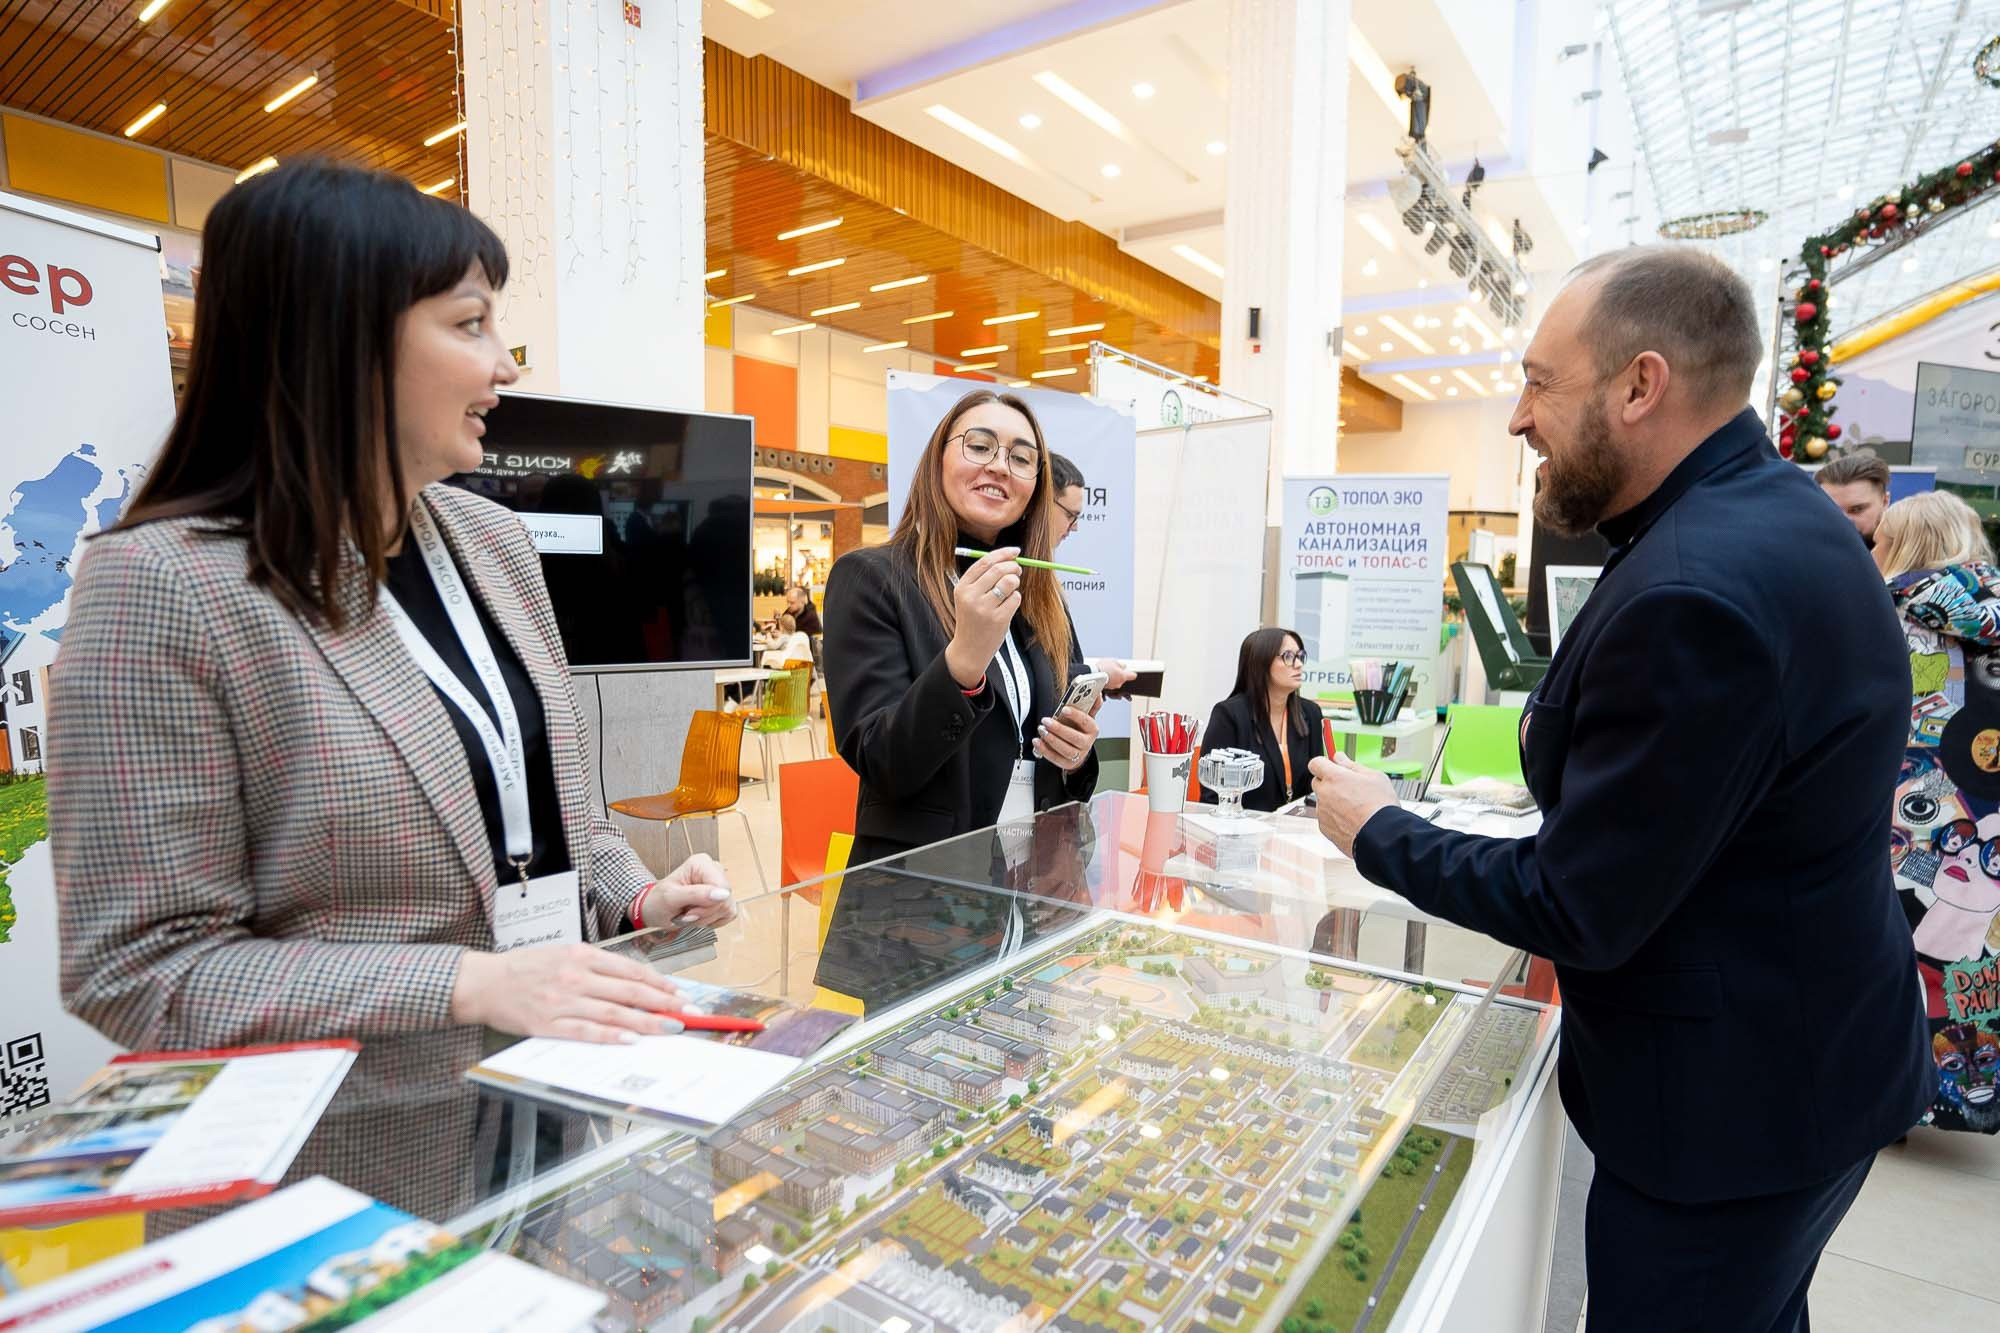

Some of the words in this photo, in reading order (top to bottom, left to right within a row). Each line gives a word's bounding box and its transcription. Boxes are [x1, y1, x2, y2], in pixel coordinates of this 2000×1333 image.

[12, 312, 95, 341] сосен
[1927, 387, 2000, 414] ЗАГОРО
[1342, 490, 1389, 505] ТОПОЛ
[1393, 491, 1423, 506] ЭКО
[1304, 522, 1421, 537] АВТОНОМНАЯ
[1298, 537, 1428, 554] КАНАЛИЗАЦИЯ
[1296, 555, 1344, 568] ТОПАС
[1348, 558, 1357, 567] и
[1361, 556, 1428, 569] ТОПАС-С
[431, 553, 462, 605] ЭКСПО
[1952, 988, 2000, 1019] PANI
